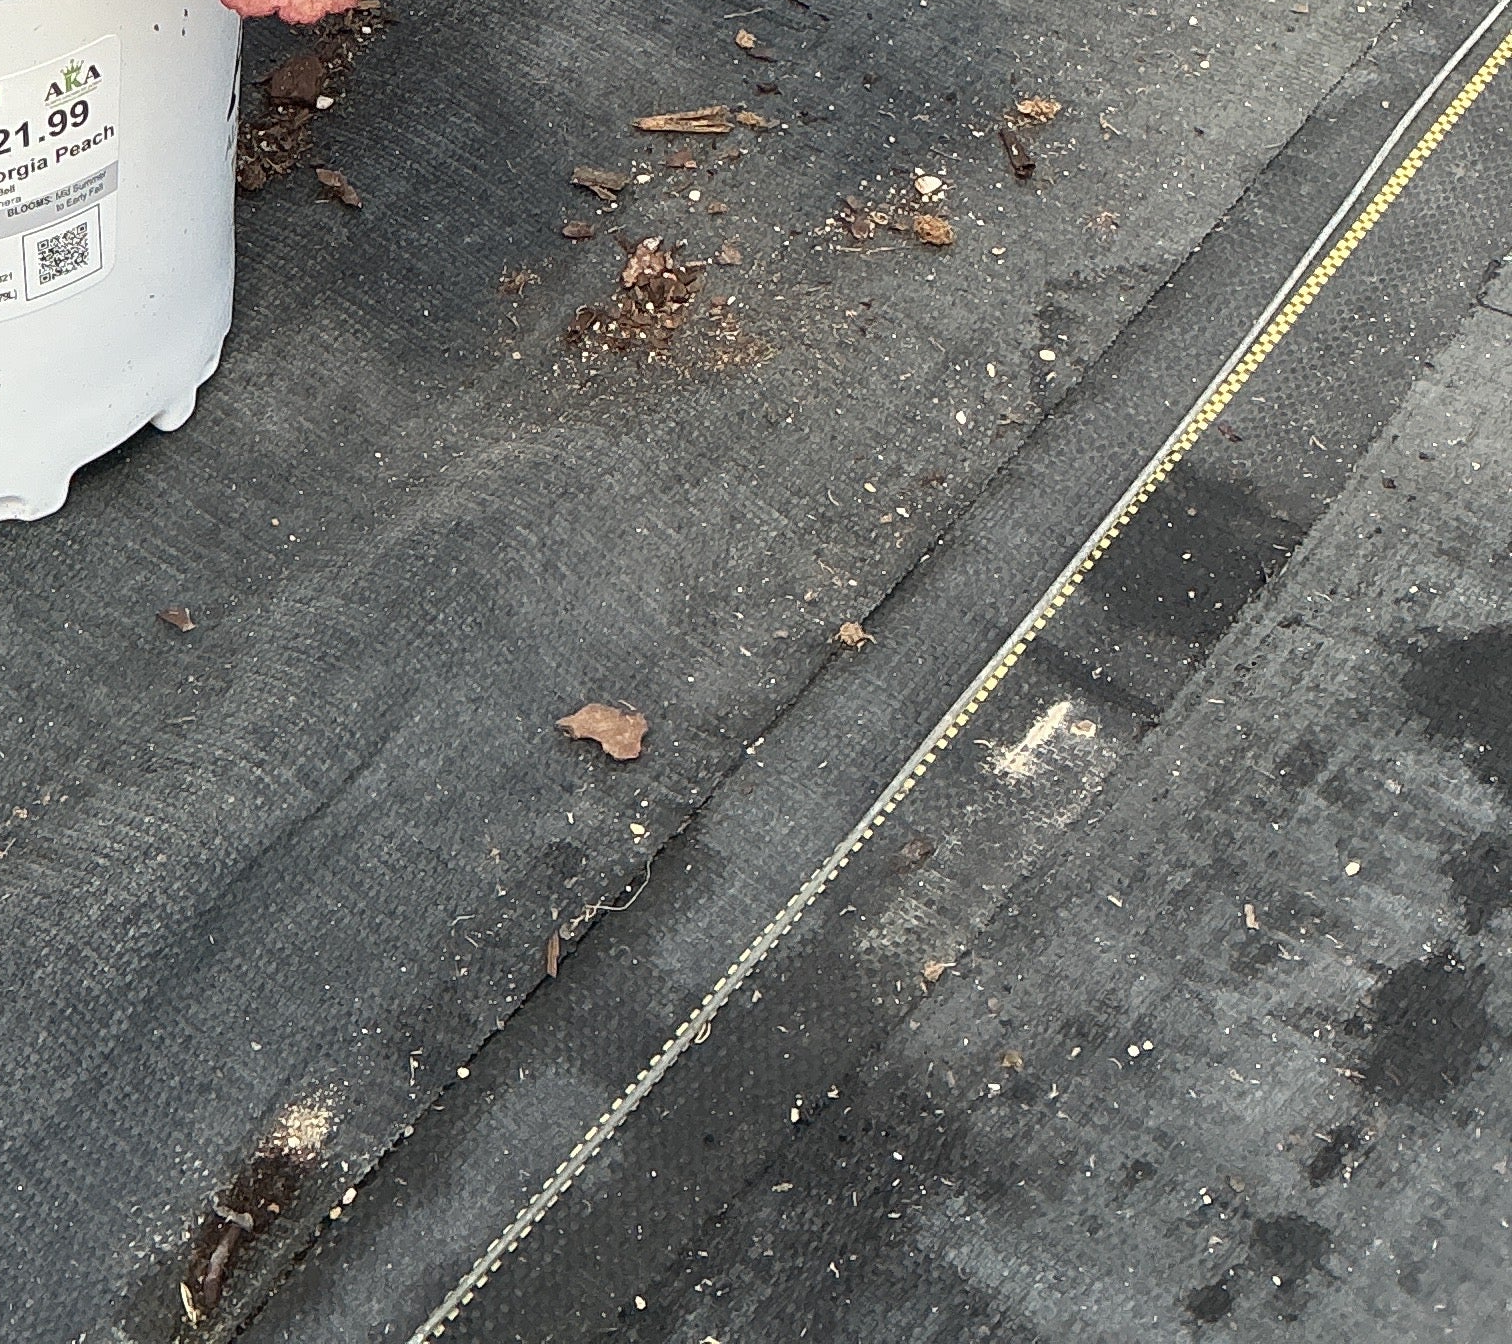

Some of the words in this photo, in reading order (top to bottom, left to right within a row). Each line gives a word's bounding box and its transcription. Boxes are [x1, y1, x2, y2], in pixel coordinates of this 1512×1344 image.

[44, 64, 102, 102] AKA
[55, 124, 115, 163] Peach
[66, 193, 87, 208] Early
[88, 182, 104, 197] Fall
[73, 170, 107, 193] Summer
